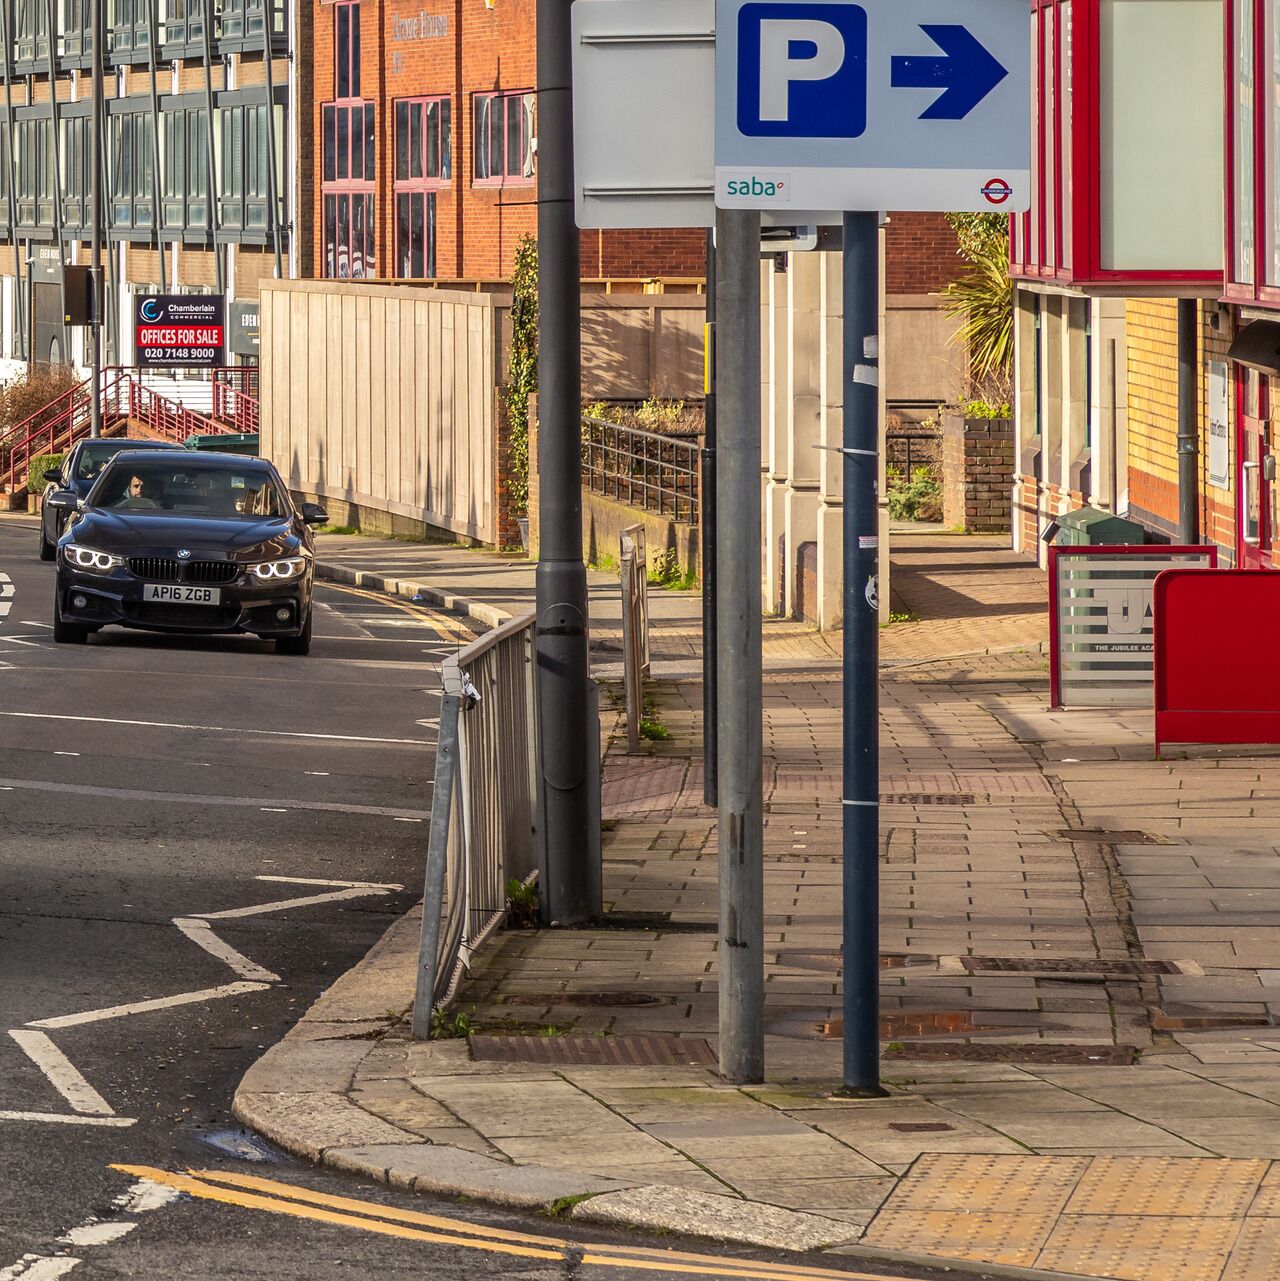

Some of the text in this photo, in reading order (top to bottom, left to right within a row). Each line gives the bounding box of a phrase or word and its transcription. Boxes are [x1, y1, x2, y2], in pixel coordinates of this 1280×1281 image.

[759, 19, 845, 121] P
[727, 176, 776, 196] saba
[168, 304, 215, 312] Chamberlain
[141, 329, 218, 345] OFFICES FOR SALE
[145, 348, 215, 358] 020 7148 9000
[152, 586, 212, 602] AP16 ZGB
